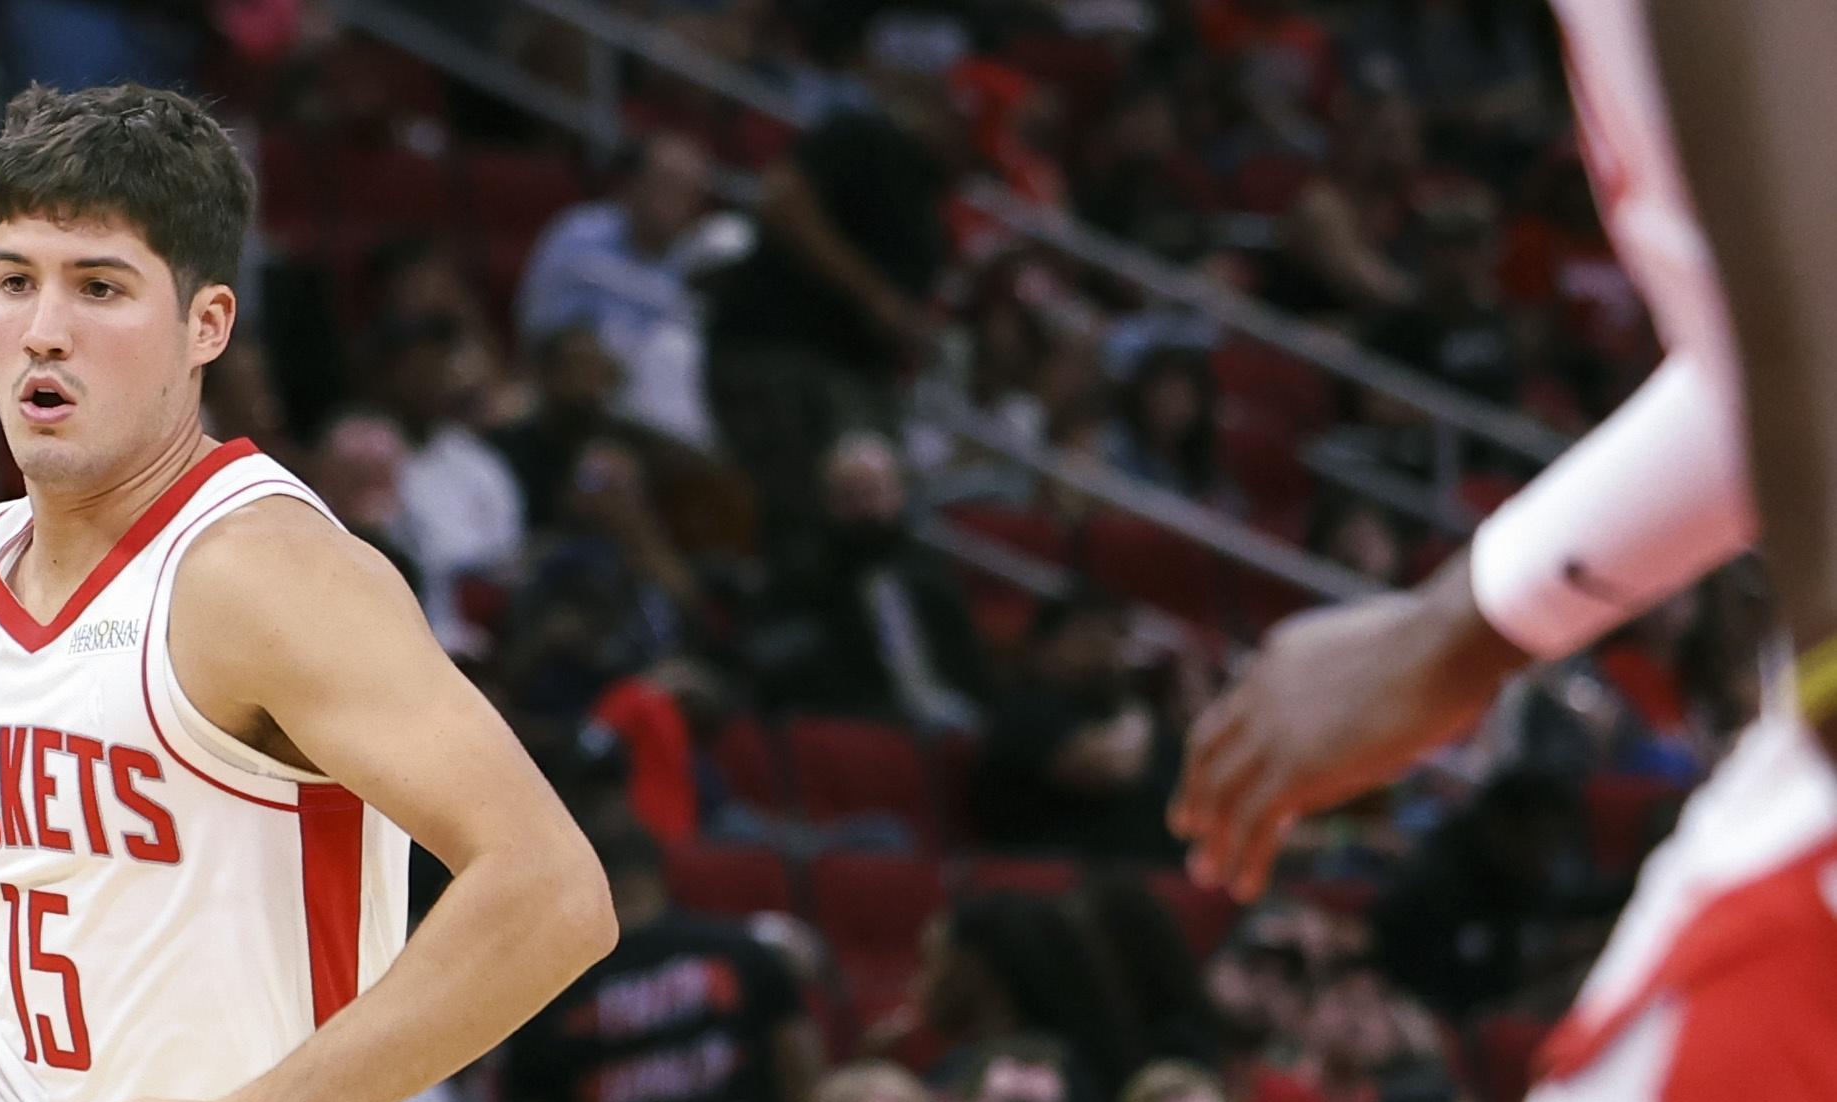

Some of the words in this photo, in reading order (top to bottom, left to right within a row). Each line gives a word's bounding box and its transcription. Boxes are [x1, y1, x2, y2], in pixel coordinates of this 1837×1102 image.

[72, 618, 140, 641] MEMORIAL
[67, 631, 138, 655] HERMANN
[0, 882, 91, 1072] 15
